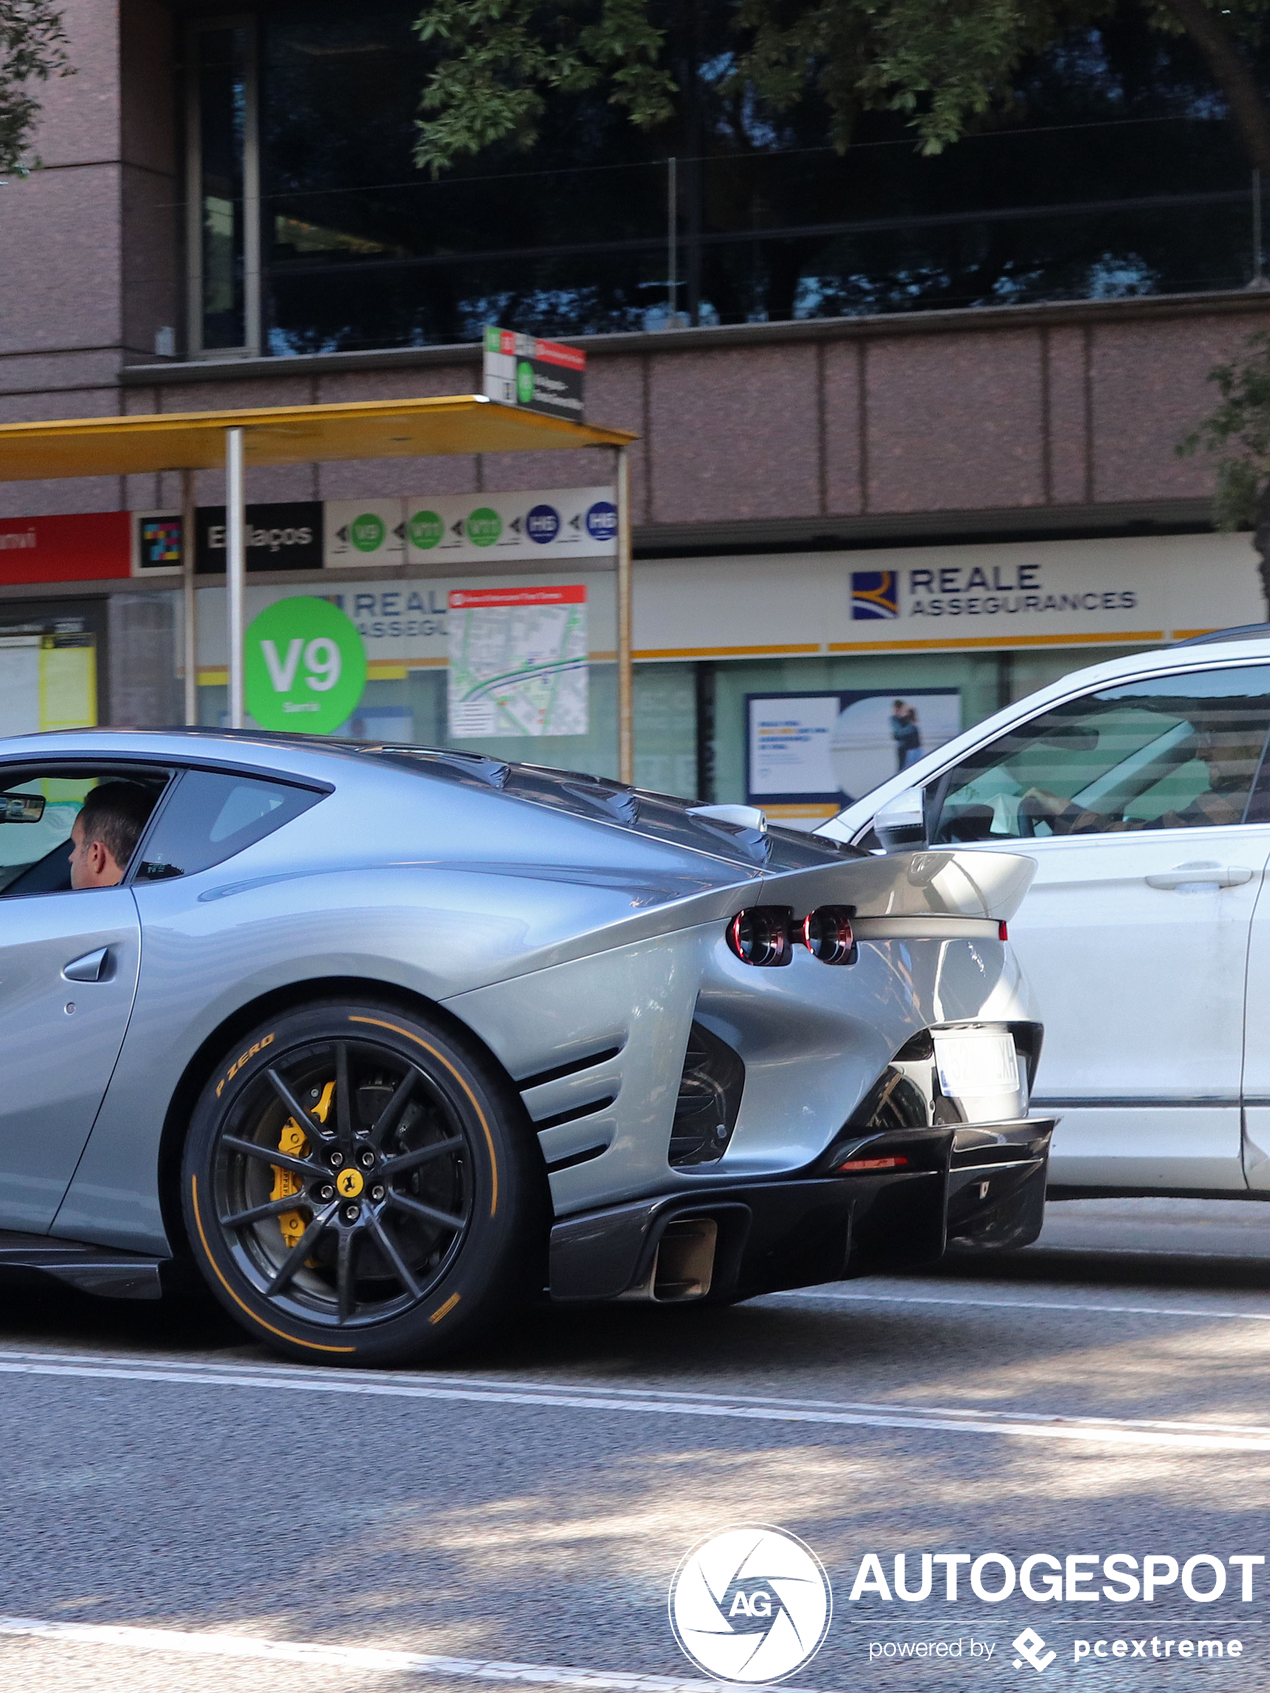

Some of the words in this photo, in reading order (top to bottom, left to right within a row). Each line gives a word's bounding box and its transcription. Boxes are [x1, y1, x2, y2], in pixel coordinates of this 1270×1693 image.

[909, 564, 1041, 595] REALE
[909, 591, 1137, 618] ASSEGURANCES
[259, 637, 342, 693] V9
[215, 1078, 225, 1098] P
[226, 1032, 276, 1081] ZERO
